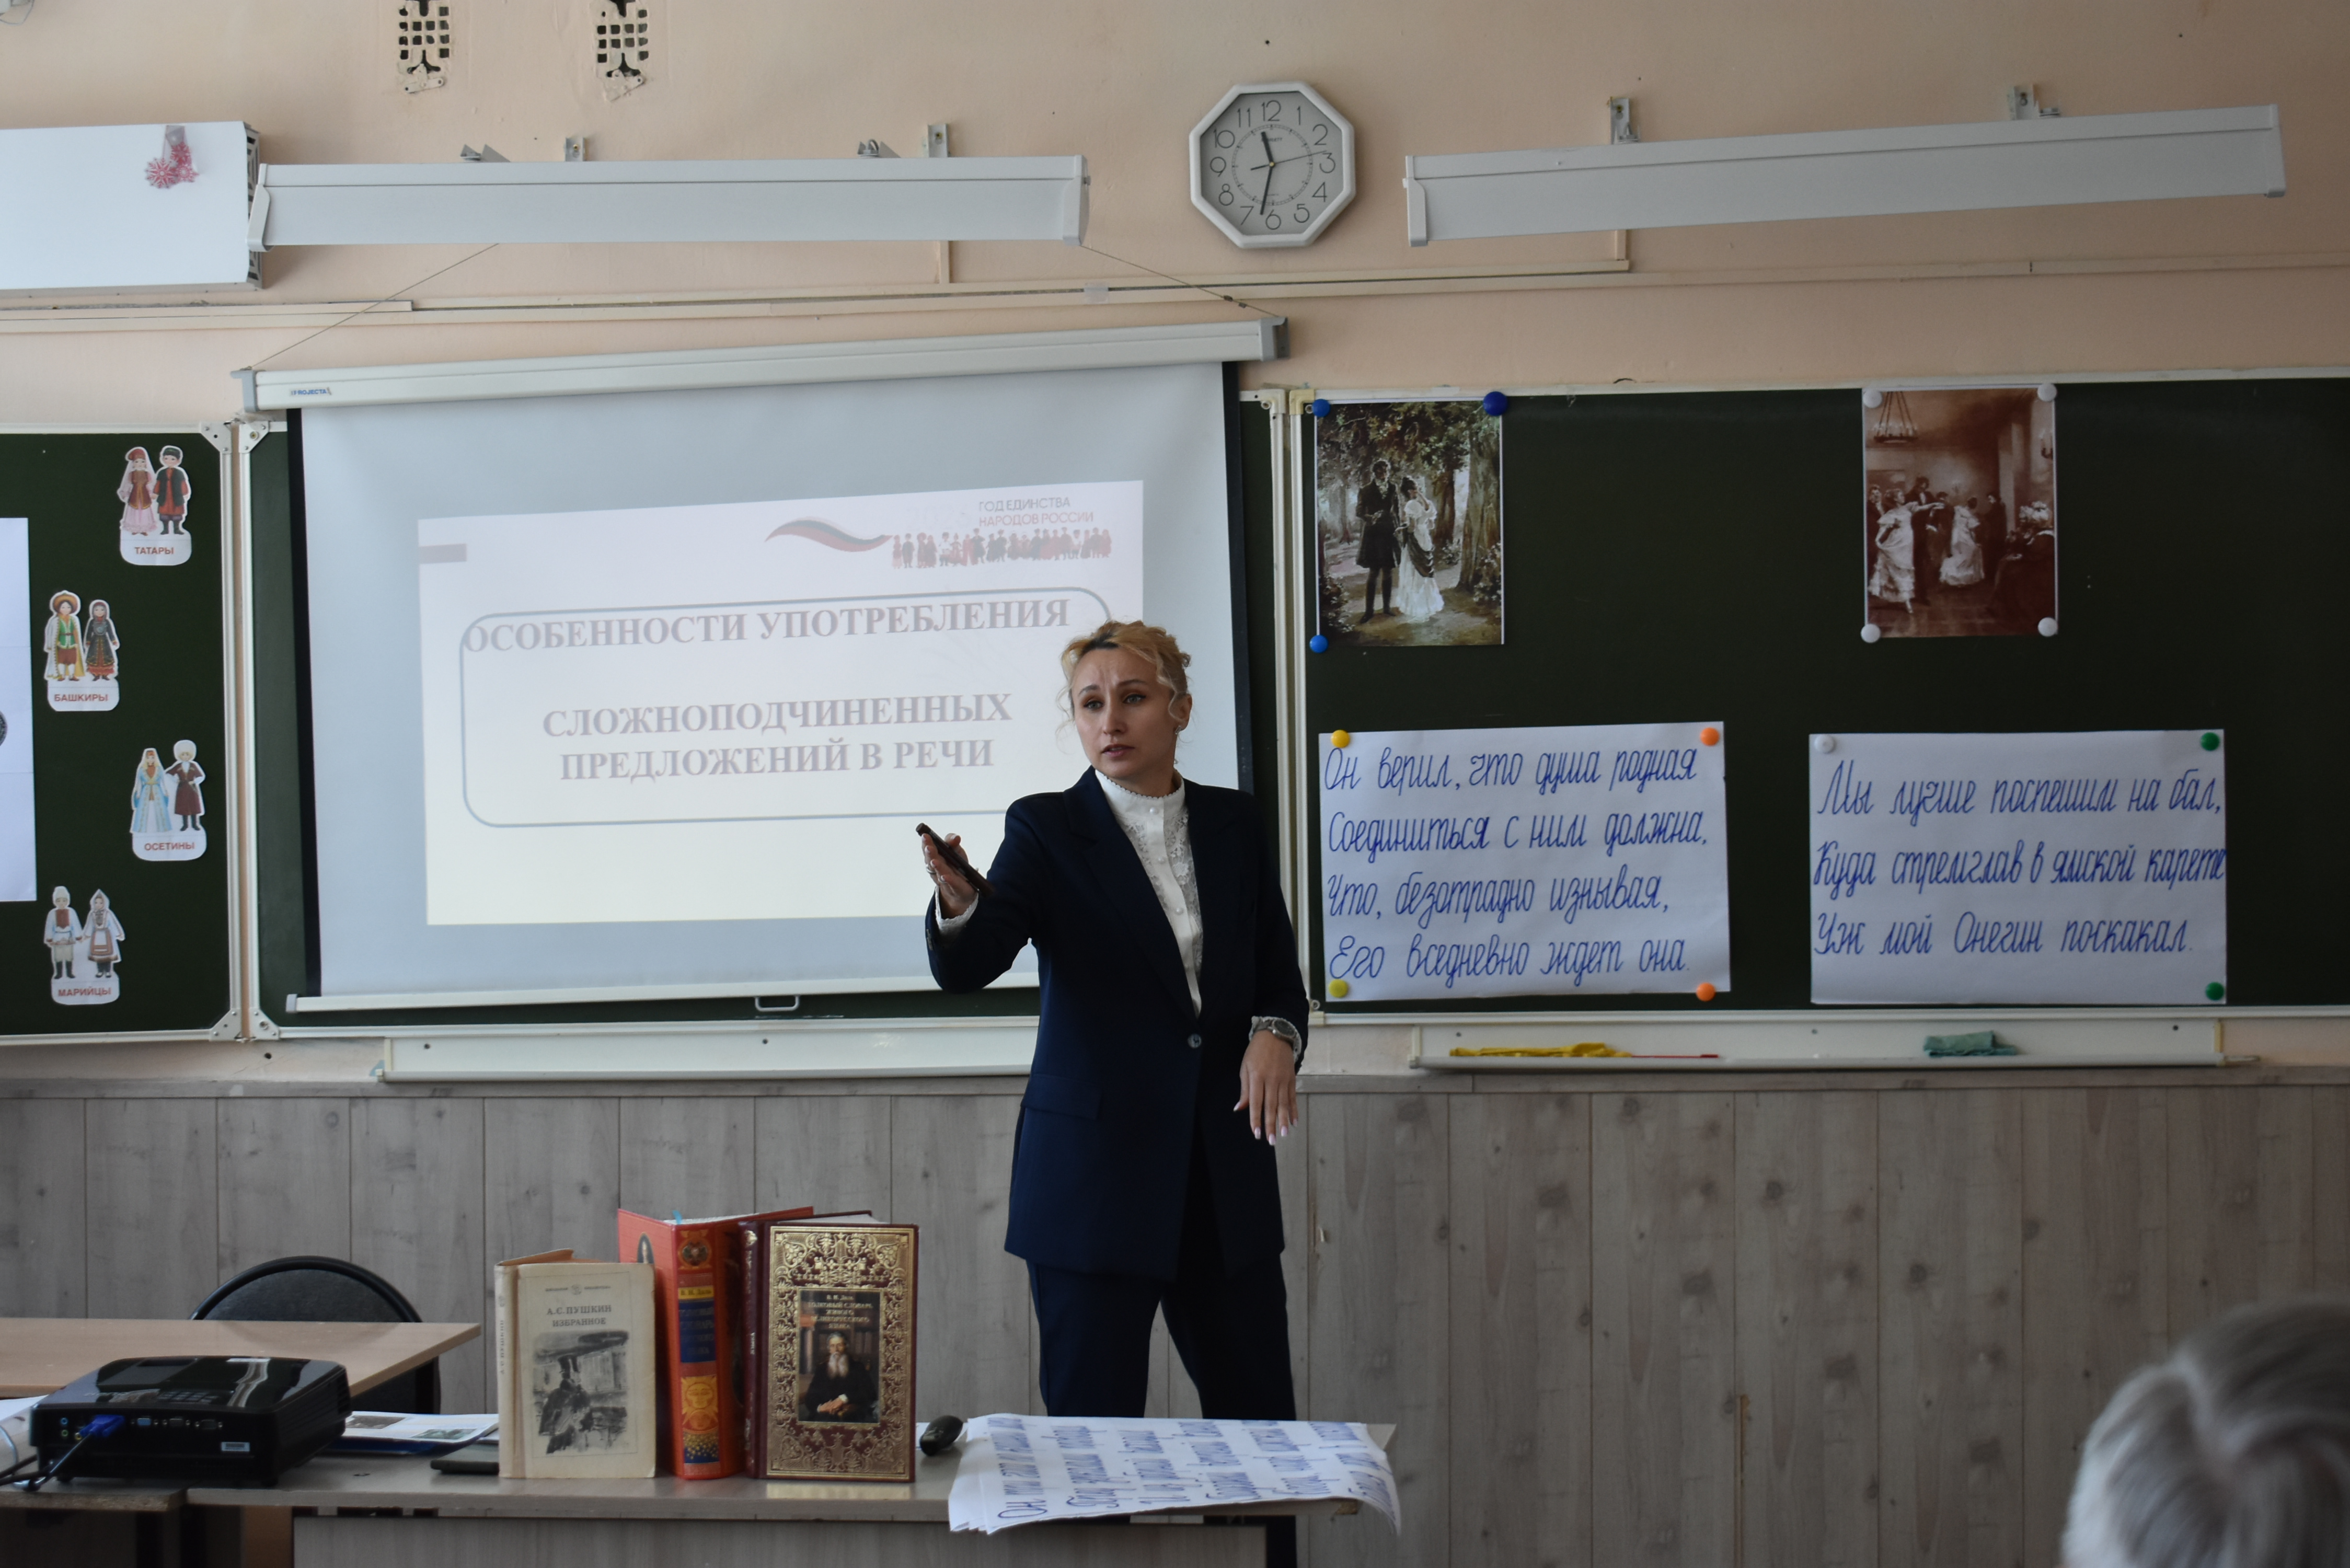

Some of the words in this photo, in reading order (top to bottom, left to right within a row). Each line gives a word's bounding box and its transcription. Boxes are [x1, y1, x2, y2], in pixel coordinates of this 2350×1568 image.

[1237, 108, 1251, 128] 11
[1261, 100, 1282, 121] 12
[1297, 106, 1301, 125] 1
[1214, 128, 1235, 148] 10
[1312, 124, 1328, 145] 2
[1209, 157, 1226, 178] 9
[1319, 152, 1335, 174] 3
[1218, 183, 1234, 206] 8
[1311, 182, 1327, 203] 4
[1240, 206, 1254, 226] 7
[1265, 209, 1281, 230] 6
[1294, 204, 1310, 223] 5
[979, 500, 1004, 513] ГОД
[1007, 497, 1071, 512] ЕДИНСТВА
[979, 513, 1039, 527] НАРОДОВ
[1041, 512, 1094, 525] РОССИИ
[134, 547, 175, 556] ТАТАРЫ
[463, 613, 747, 652] ОСОБЕННОСТИ
[756, 598, 1072, 640] УПОТРЕБЛЕНИЯ
[54, 693, 108, 702] БАШКИРЫ
[543, 693, 1012, 737] СЛОЖНОПОДЧИНЕННЫХ
[560, 737, 850, 783] ПРЕДЛОЖЕНИЙ
[859, 742, 883, 770] В
[894, 739, 994, 769] РЕЧИ
[1324, 748, 1361, 790] Он
[1378, 747, 1460, 795] верил,
[1469, 752, 1523, 787] что
[1535, 750, 1601, 795] душа
[1609, 747, 1698, 791] родная
[1817, 759, 1874, 816] Мы
[1889, 779, 1977, 827] лучше
[1990, 778, 2119, 816] поспешим
[2127, 778, 2161, 812] на
[2168, 769, 2221, 815] бал,
[144, 841, 195, 851] ОСЕТИНЫ
[1328, 811, 1490, 863] Соединиться
[1505, 814, 1518, 848] с
[1529, 814, 1586, 848] ним
[1604, 810, 1708, 857] должна,
[1814, 841, 1877, 900] Куда
[1891, 839, 2025, 895] стремглав
[2030, 840, 2045, 884] в
[2051, 845, 2137, 885] ямской
[2144, 848, 2226, 891] карете
[1327, 874, 1381, 919] Что,
[1395, 872, 1535, 929] безотрадно
[1549, 864, 1668, 924] изнывая,
[1814, 912, 1865, 954] Уж
[1879, 915, 1935, 955] мой
[1954, 911, 2044, 954] Онегин
[1330, 936, 1385, 979] Его
[1407, 933, 1529, 988] вседневно
[1540, 939, 1623, 986] ждет
[57, 986, 112, 997] МАРИЙЦЫ
[566, 1305, 612, 1315] ПУШКИН
[552, 1318, 606, 1327] ИЗБРАННОЕ
